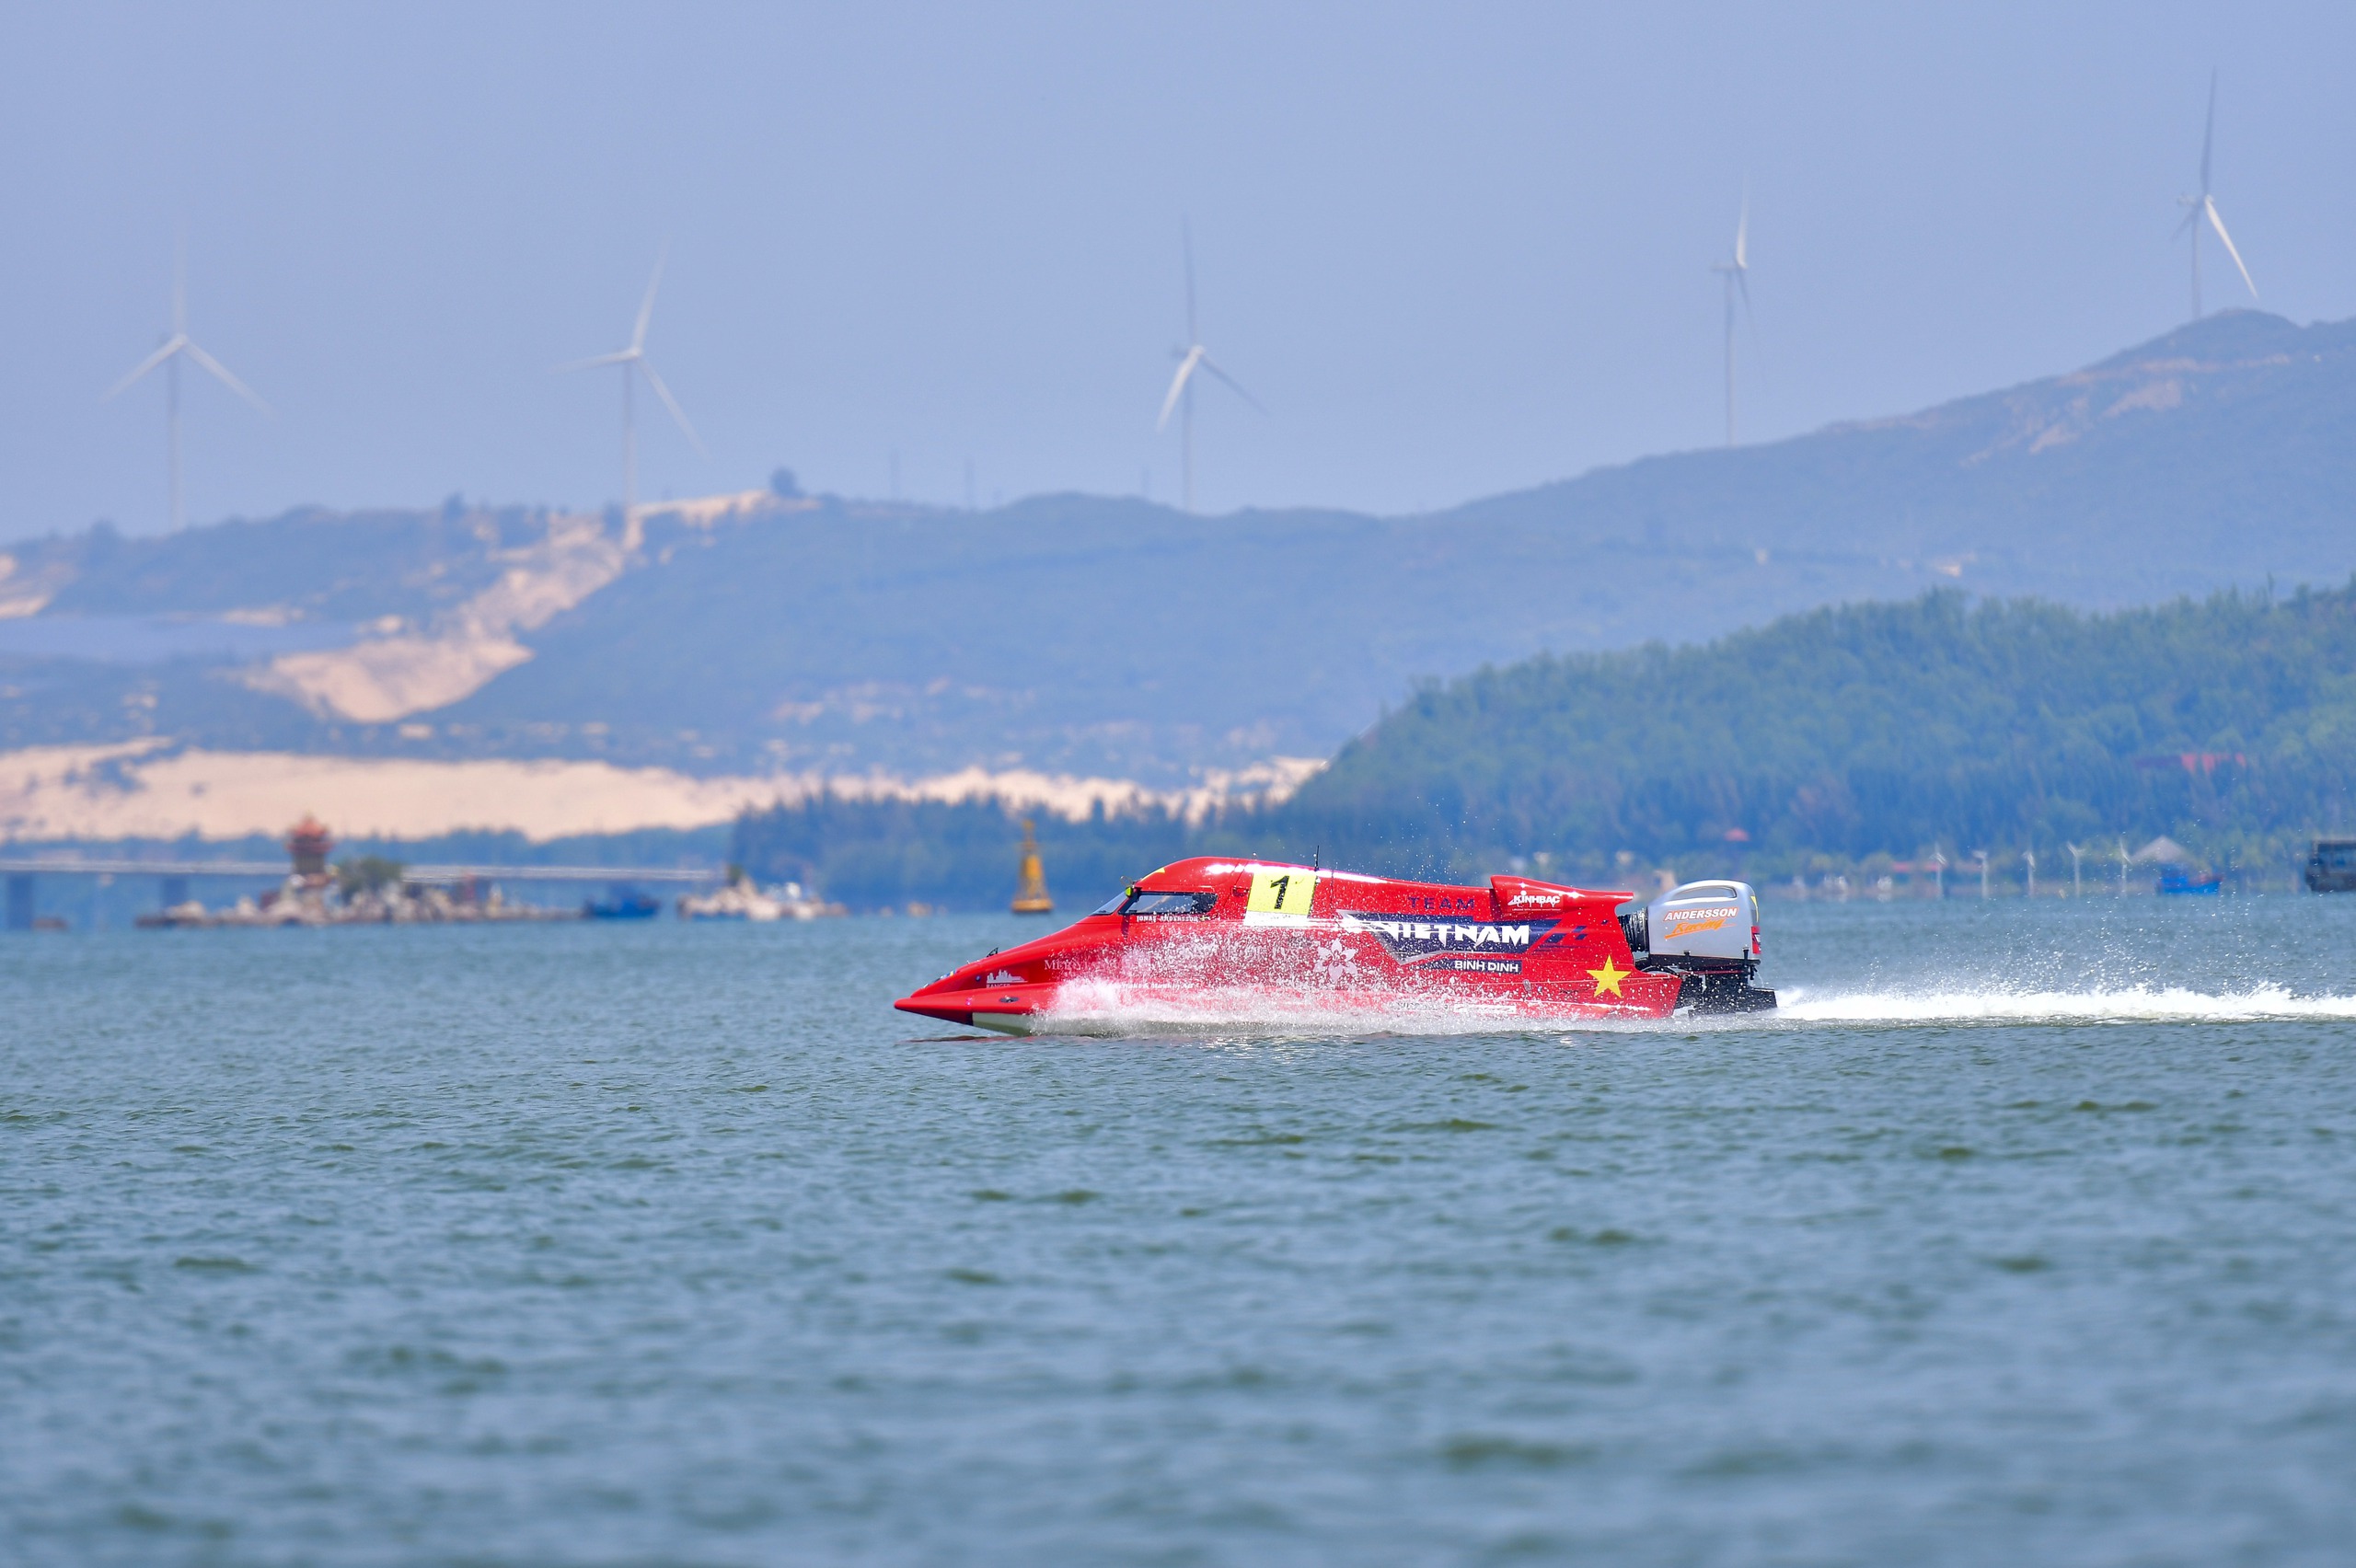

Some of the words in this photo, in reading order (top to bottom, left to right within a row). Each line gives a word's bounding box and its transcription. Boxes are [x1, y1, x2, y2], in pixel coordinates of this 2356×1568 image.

[1270, 875, 1290, 910] 1
[1510, 893, 1561, 905] KINHBAC
[1408, 896, 1475, 910] TEAM
[1663, 906, 1739, 922] ANDERSSON
[1379, 923, 1530, 948] VIETNAM
[1667, 919, 1727, 937] Racing
[1454, 960, 1485, 971] BINH
[1487, 962, 1519, 973] DINH
